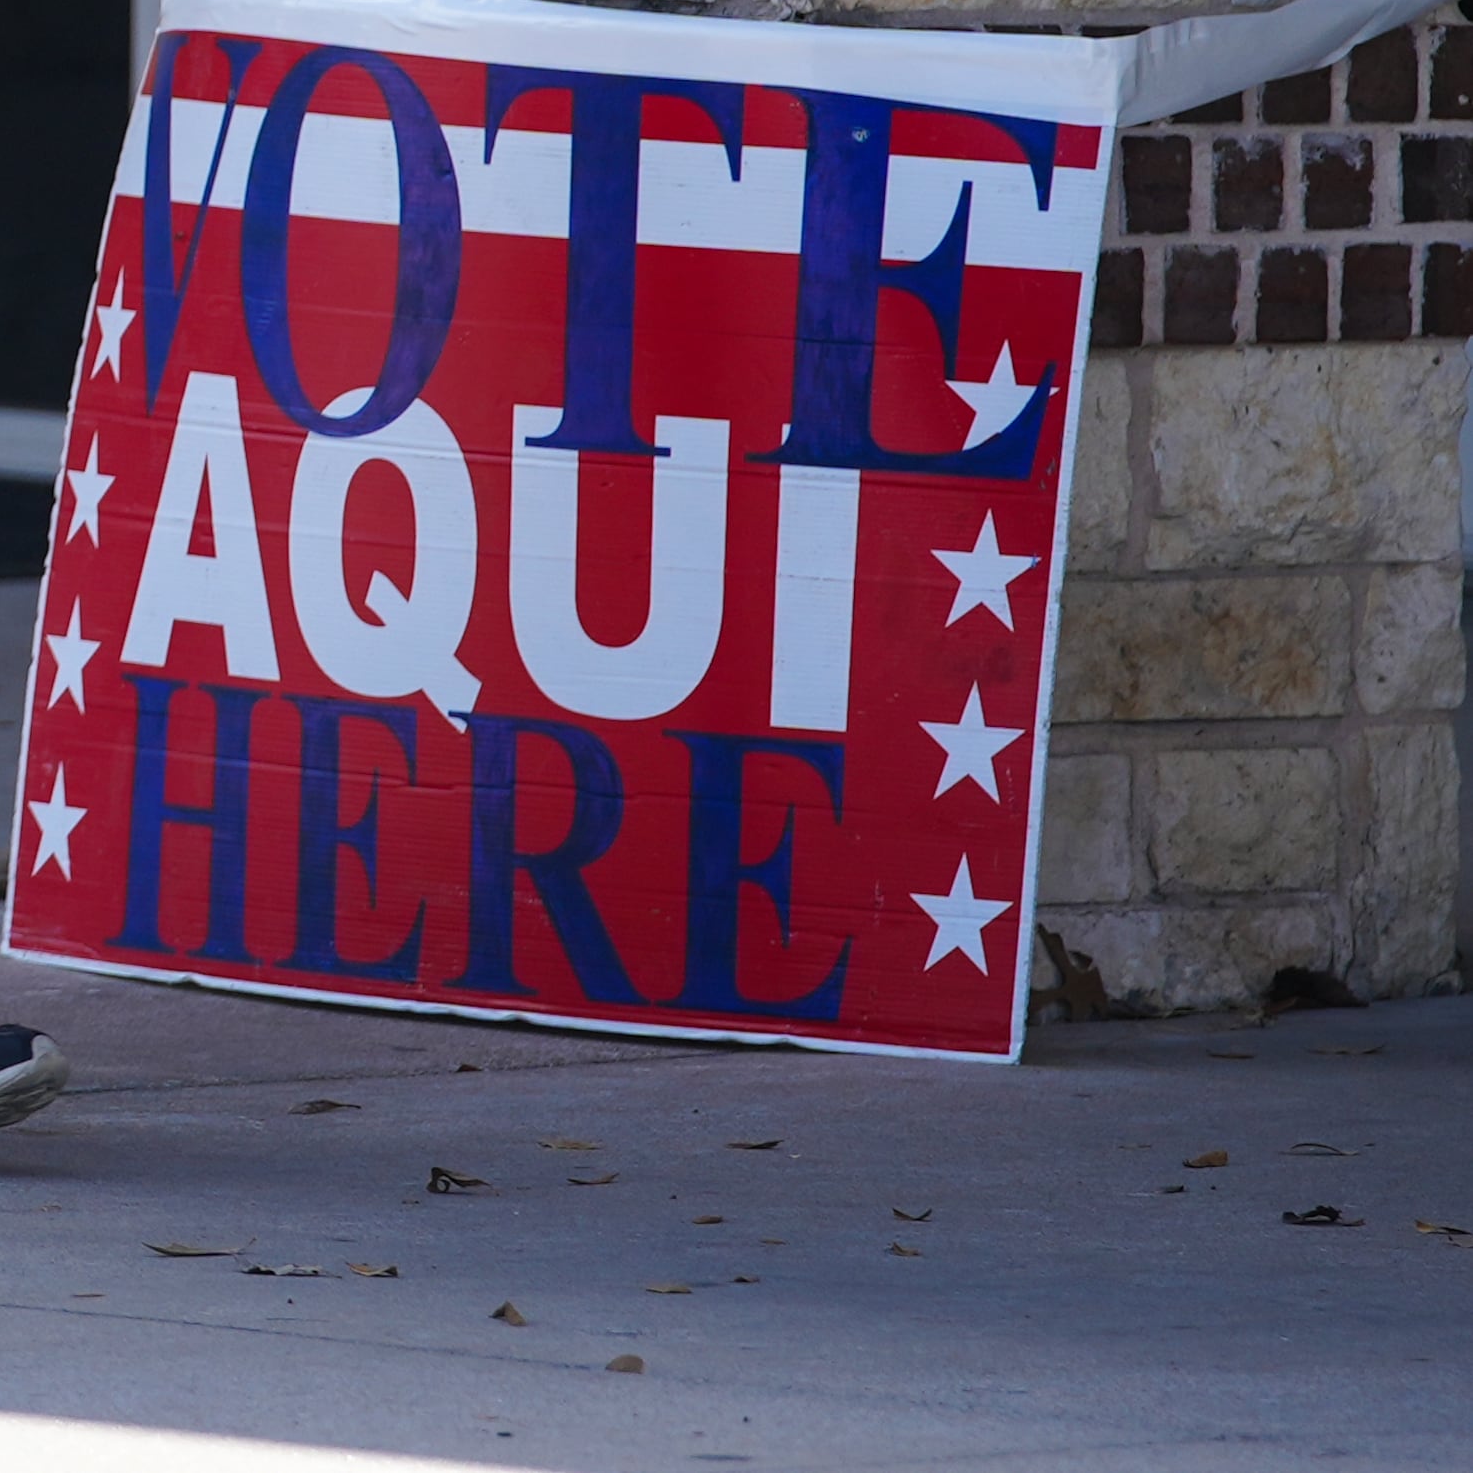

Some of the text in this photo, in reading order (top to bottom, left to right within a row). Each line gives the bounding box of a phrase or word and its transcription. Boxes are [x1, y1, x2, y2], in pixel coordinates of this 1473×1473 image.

[143, 32, 1053, 481] VOTE
[119, 371, 861, 733] AQUI
[102, 673, 853, 1020] HERE
